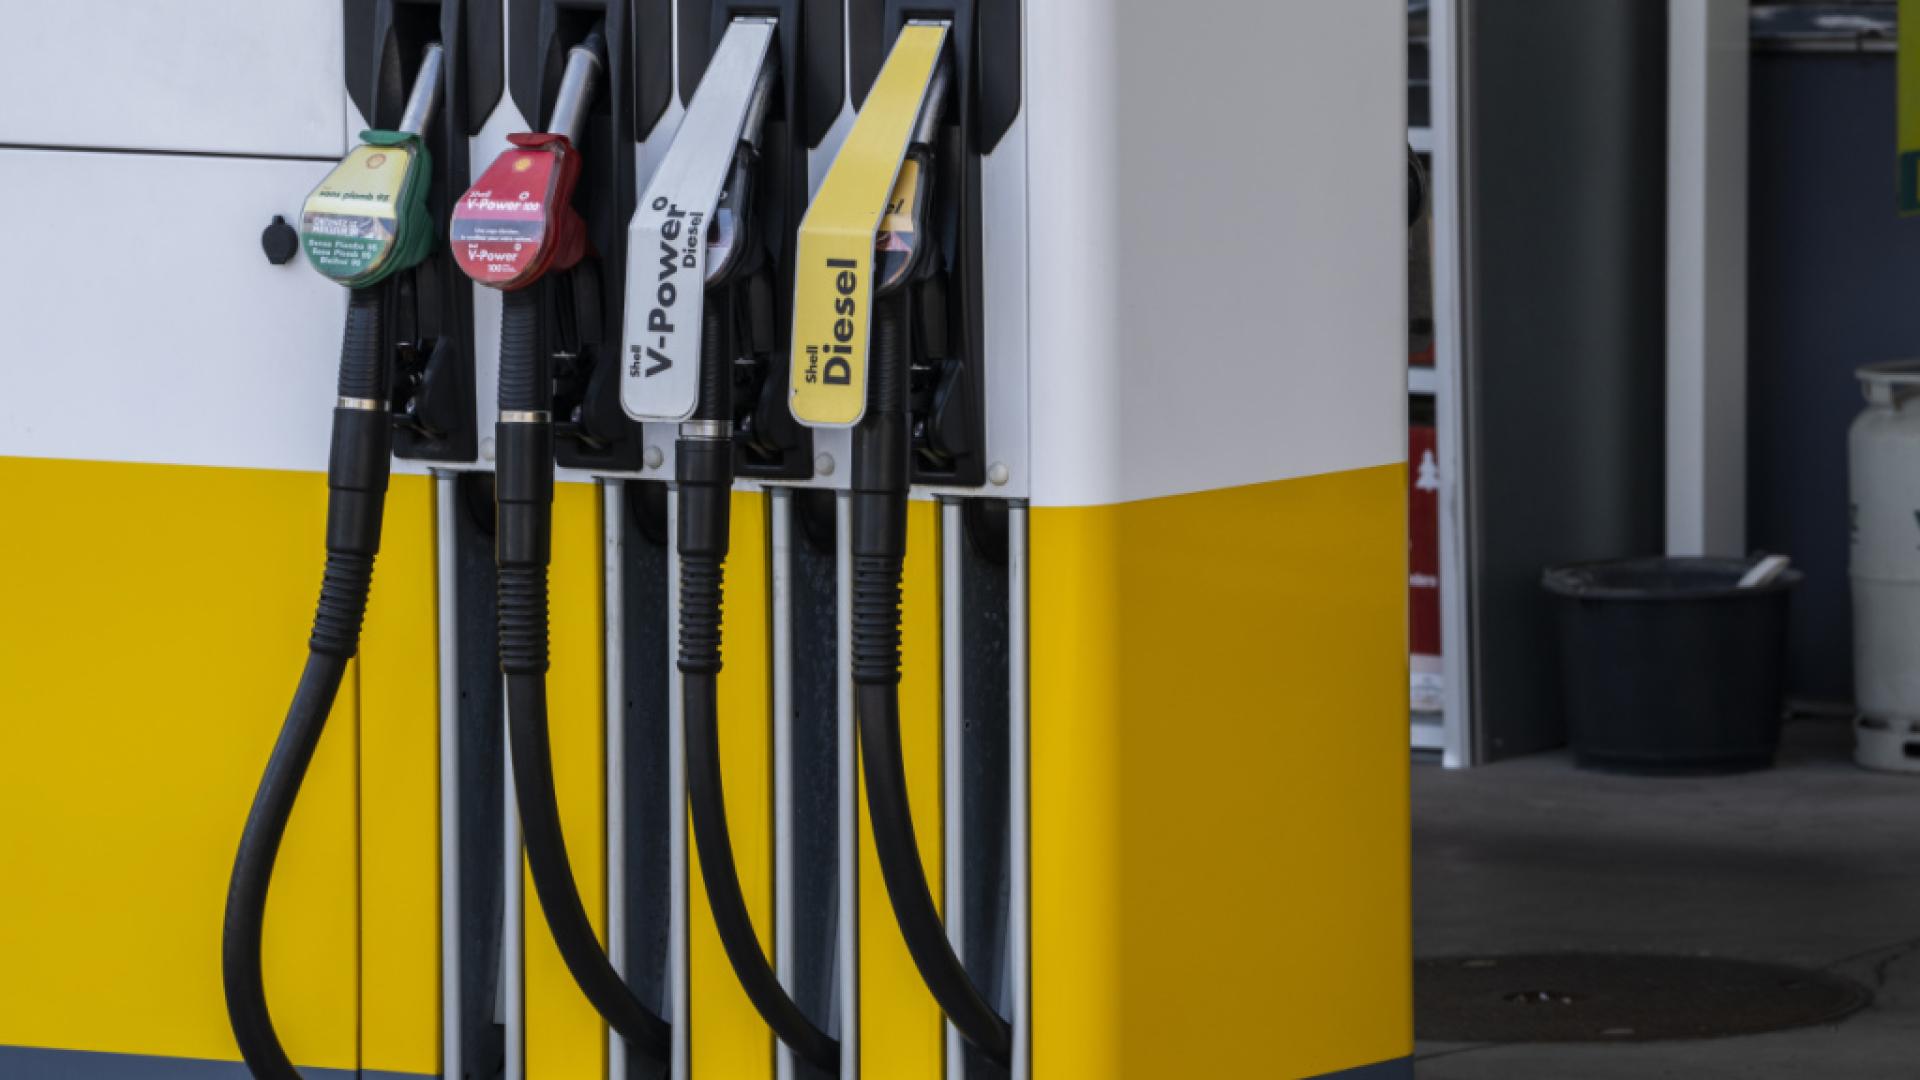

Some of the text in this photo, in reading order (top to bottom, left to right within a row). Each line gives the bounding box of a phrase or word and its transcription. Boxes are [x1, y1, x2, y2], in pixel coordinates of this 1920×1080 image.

[342, 191, 374, 201] plomb
[467, 198, 540, 211] V-Power 100
[468, 248, 518, 262] V-Power
[682, 211, 704, 268] Diesel
[645, 204, 687, 378] V-Power
[823, 258, 858, 385] Diesel
[630, 345, 642, 378] Shell
[805, 345, 818, 384] Shell
